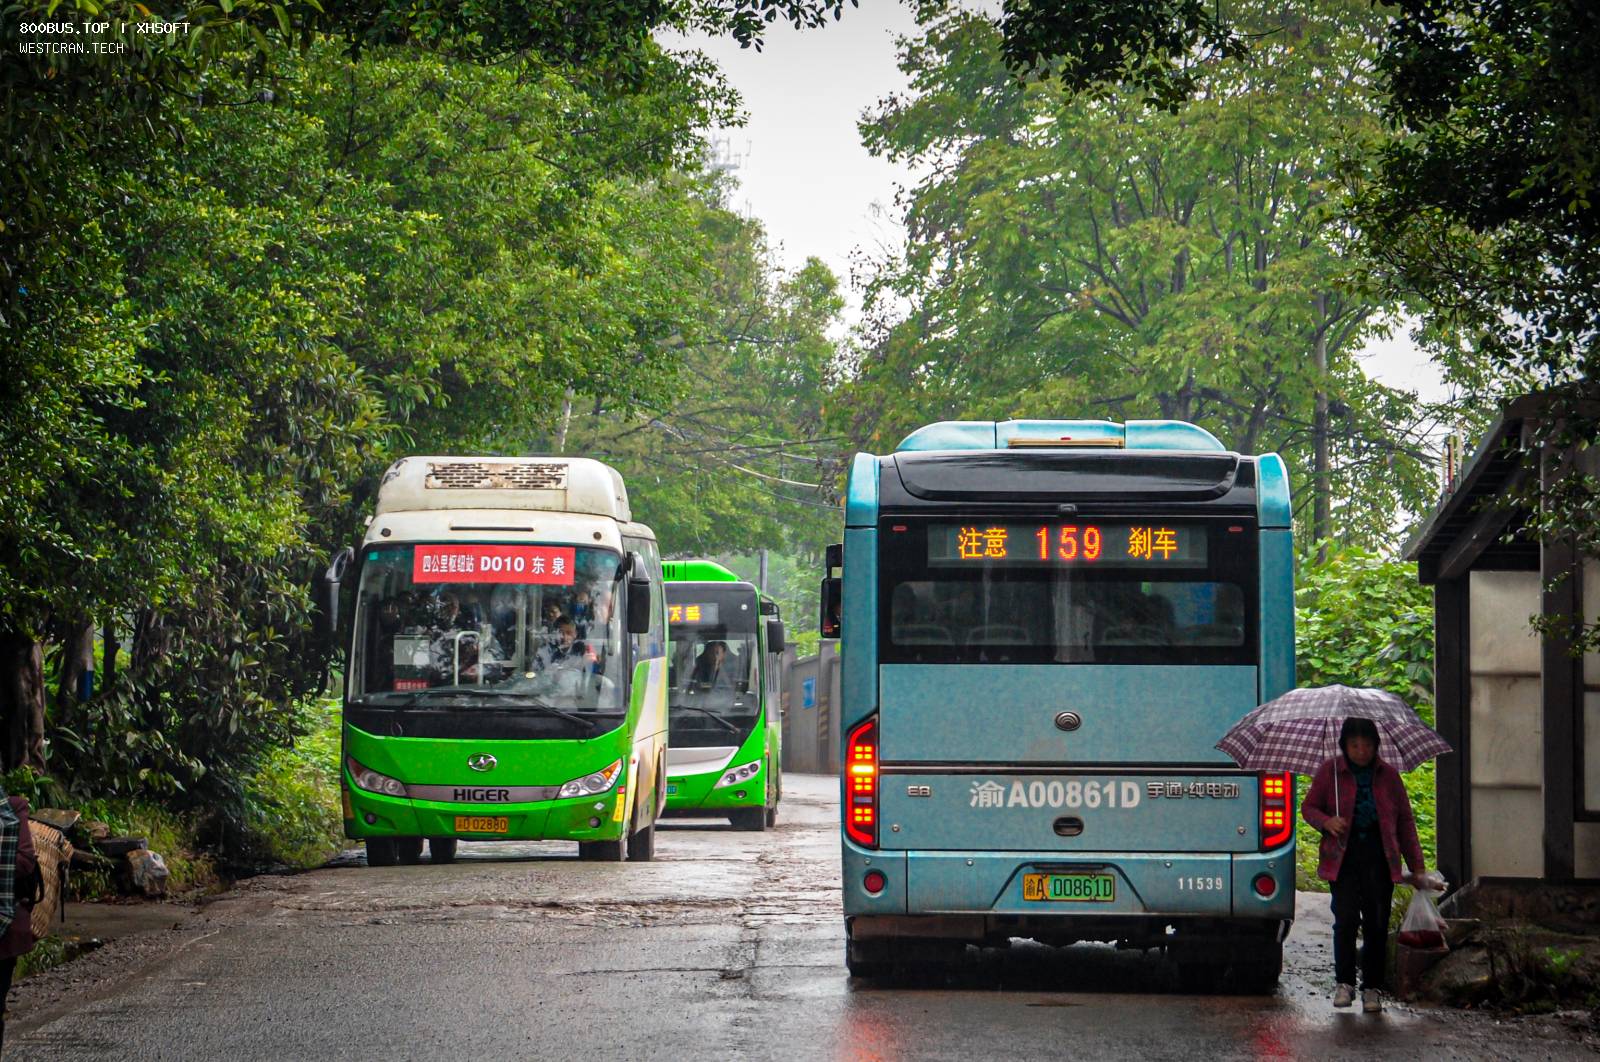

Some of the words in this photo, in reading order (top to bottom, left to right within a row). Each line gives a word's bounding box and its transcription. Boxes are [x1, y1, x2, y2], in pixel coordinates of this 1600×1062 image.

[958, 527, 1008, 560] 注意
[1036, 527, 1101, 560] 159
[1127, 527, 1178, 560] 刹车
[422, 554, 474, 573] 四公里枢纽站
[480, 556, 525, 572] D010
[453, 788, 510, 801] HIGER
[969, 780, 1141, 809] 渝A00861D
[1177, 877, 1224, 890] 11539
